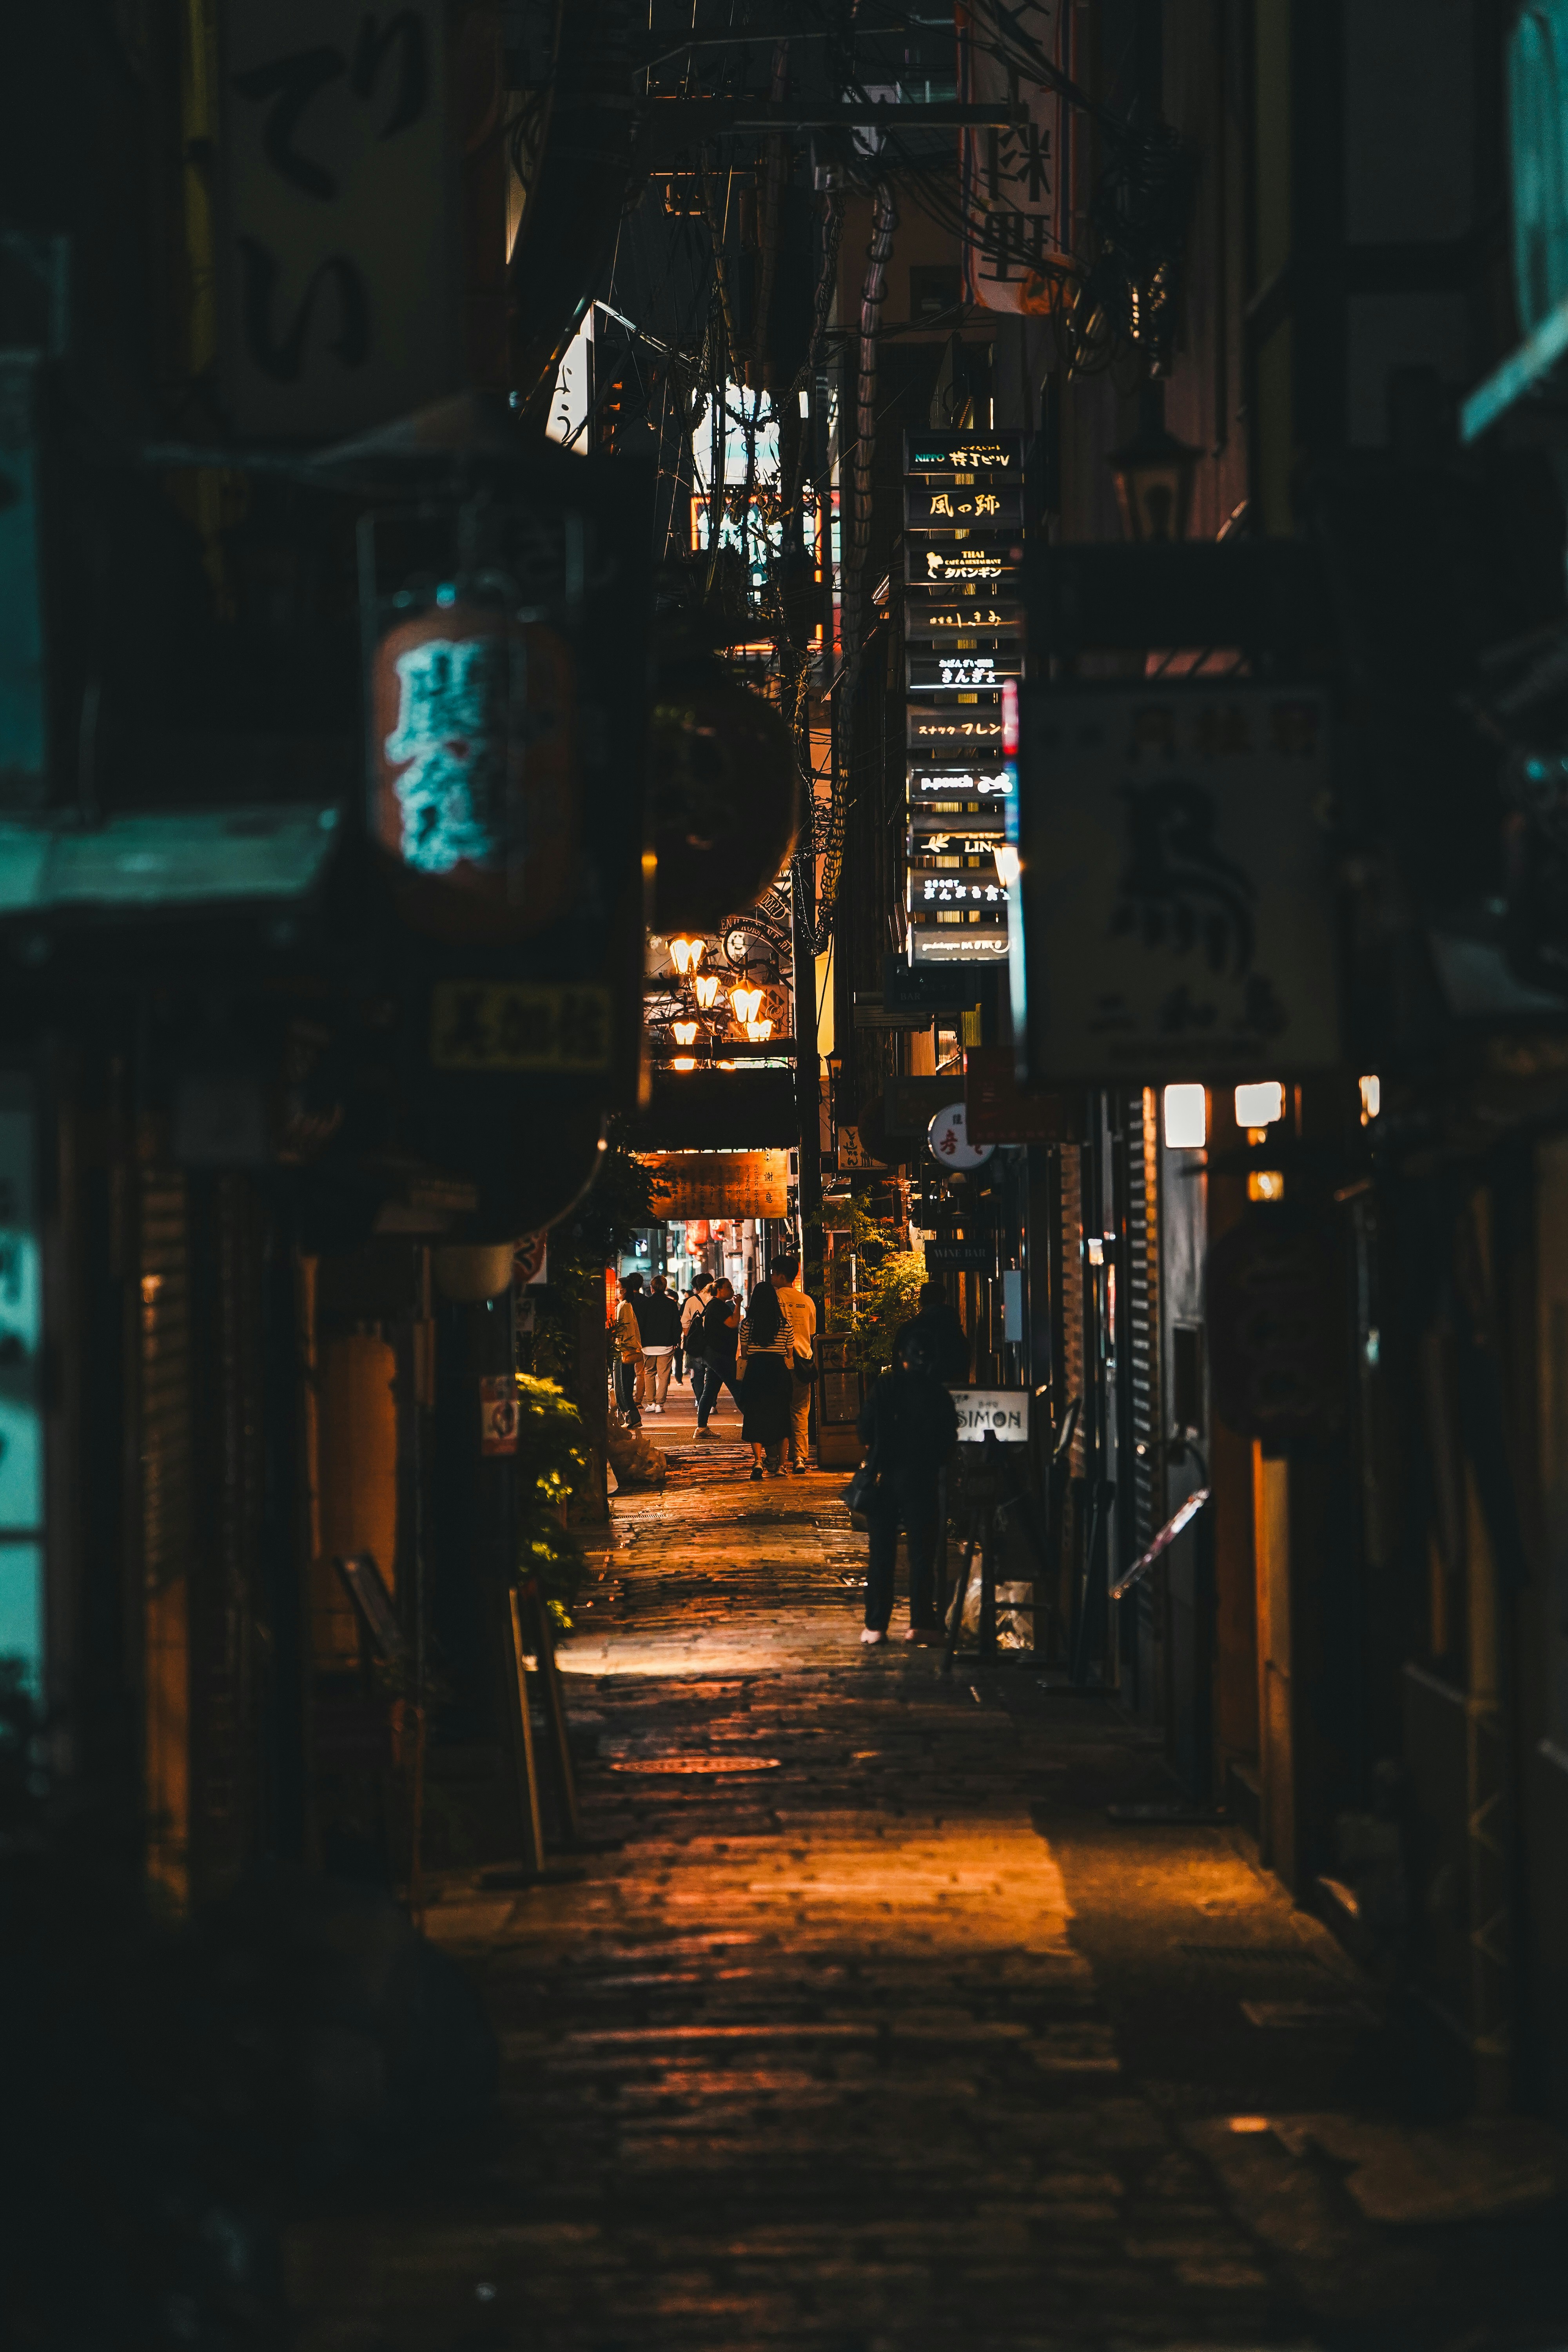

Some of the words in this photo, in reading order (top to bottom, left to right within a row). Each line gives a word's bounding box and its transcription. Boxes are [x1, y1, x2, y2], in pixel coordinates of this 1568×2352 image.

[915, 454, 945, 462] NIPPO
[930, 494, 1000, 517] 風の跡
[942, 668, 996, 683] きんぎょ
[919, 726, 956, 735] スナック
